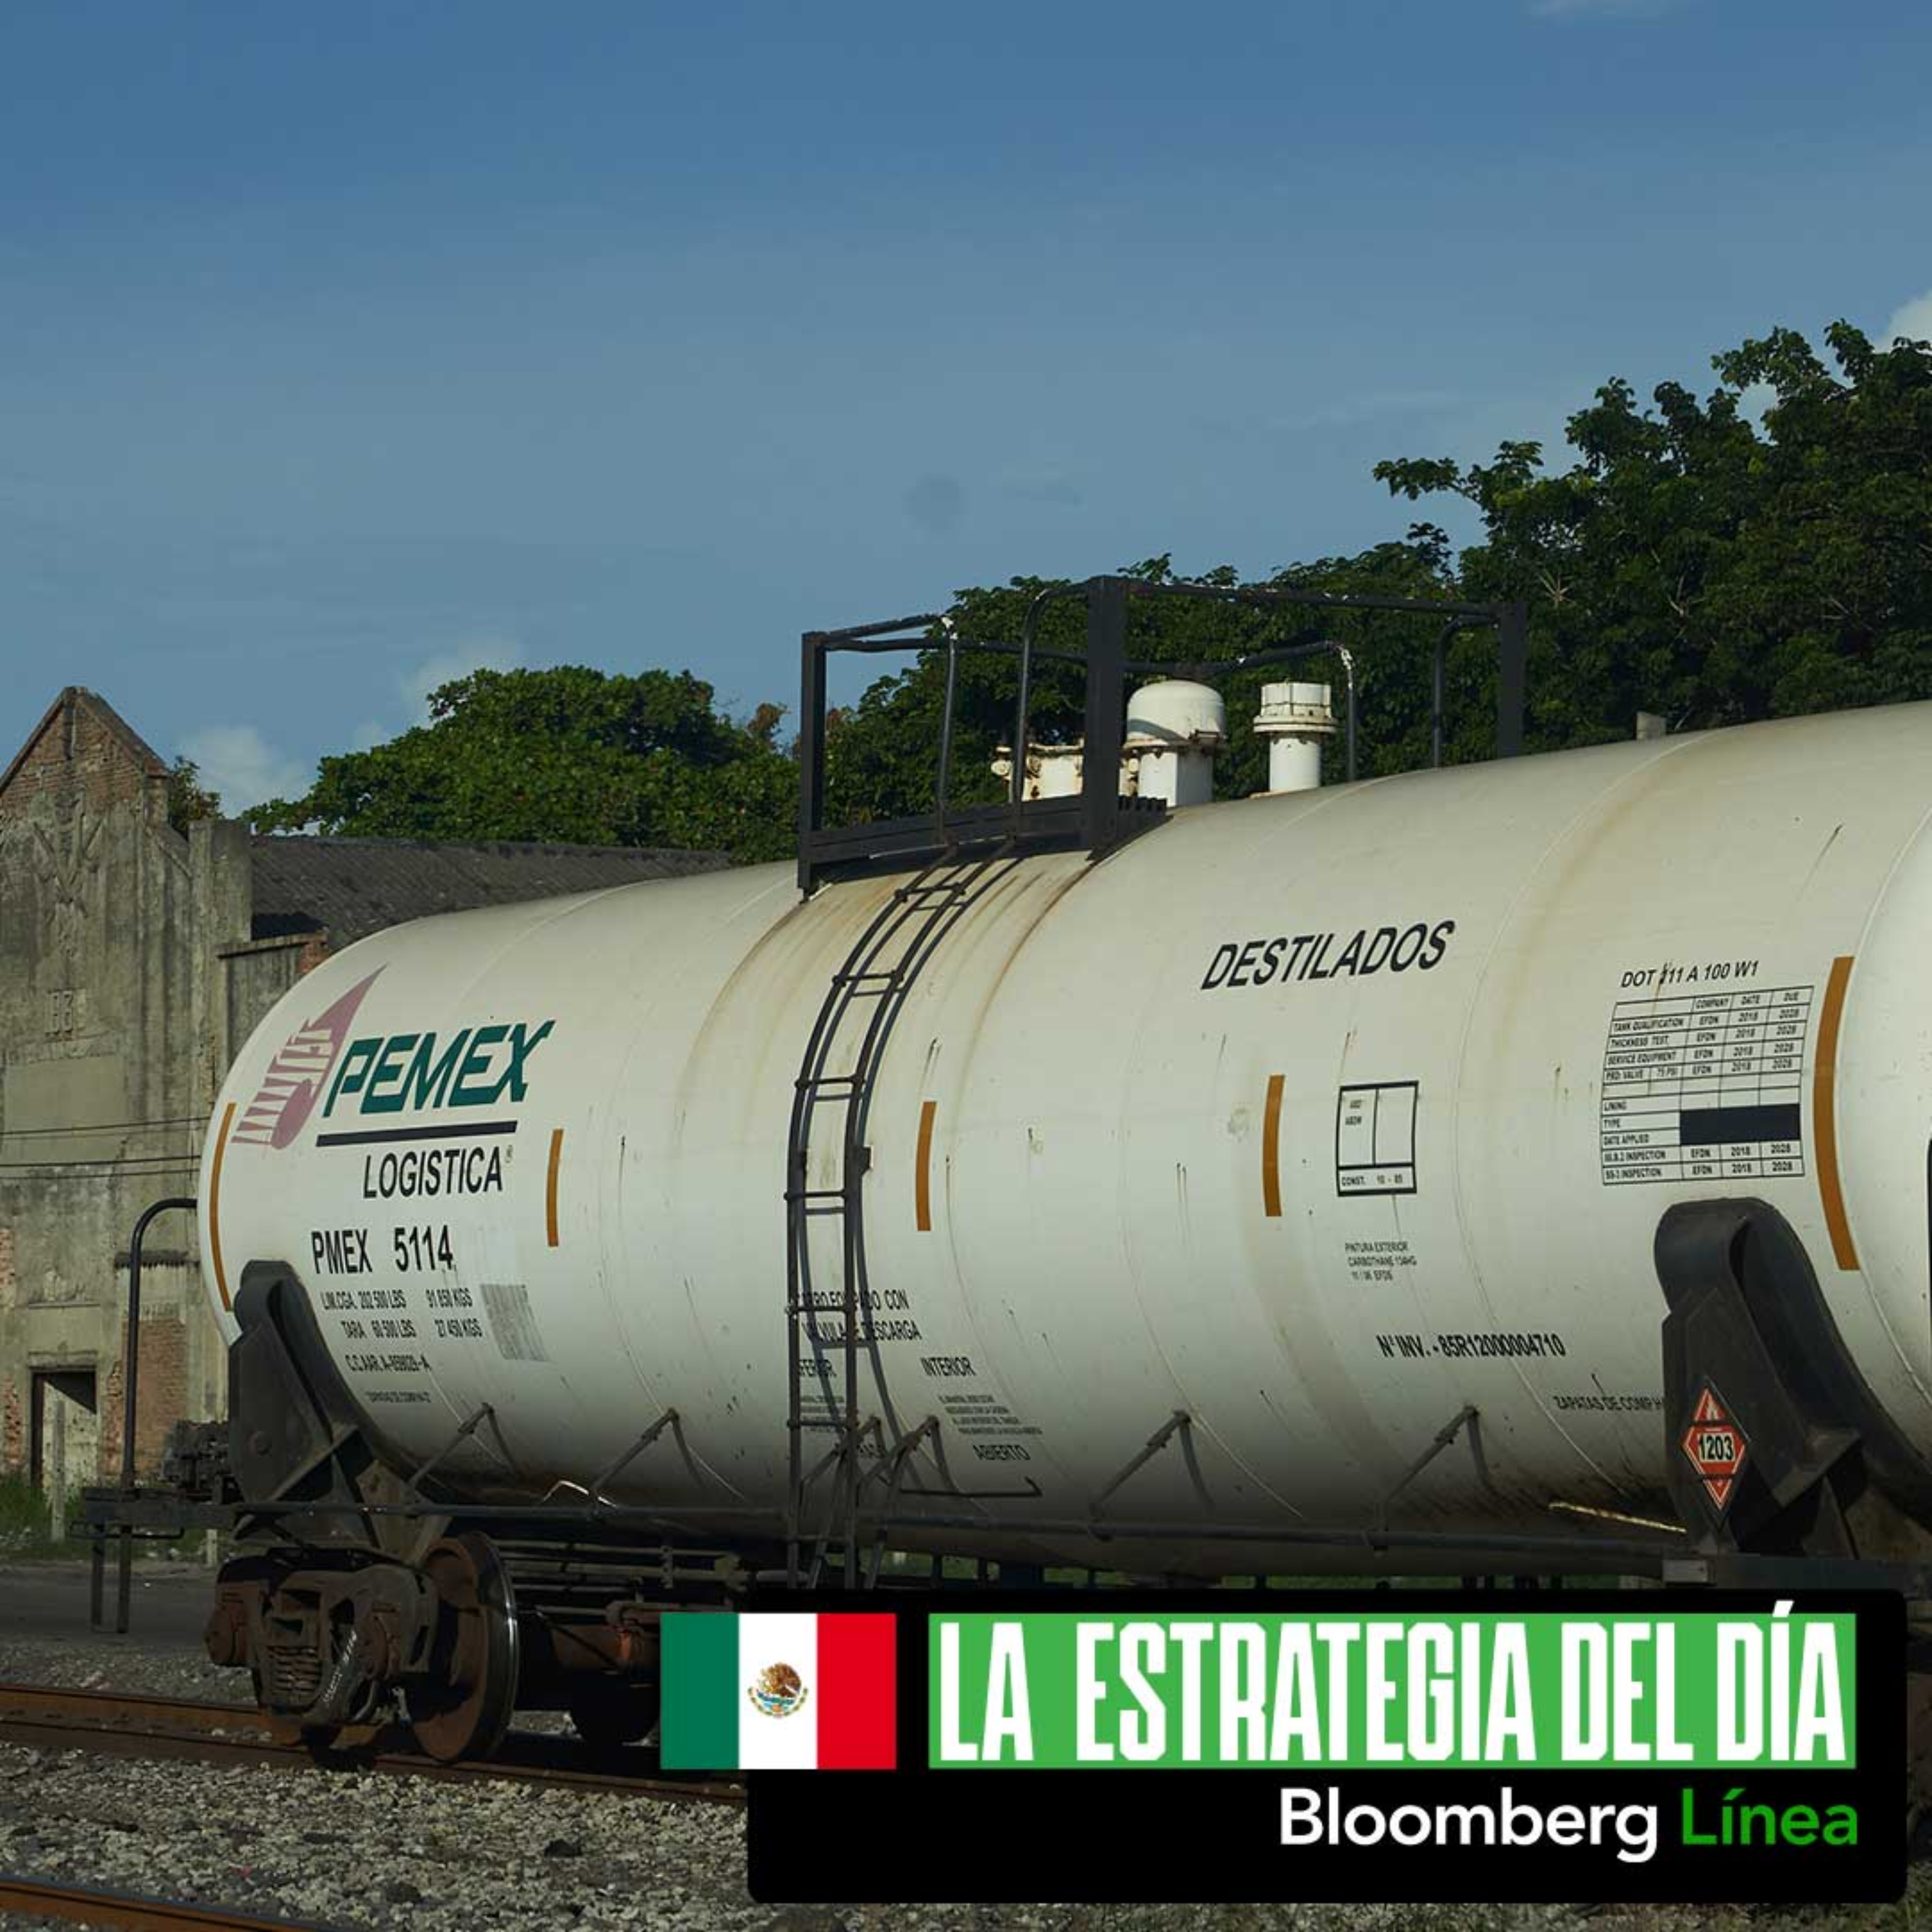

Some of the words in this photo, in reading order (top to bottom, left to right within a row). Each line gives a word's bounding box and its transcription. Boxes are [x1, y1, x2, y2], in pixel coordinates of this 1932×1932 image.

[1200, 921, 1455, 989] DESTILADOS
[1620, 970, 1657, 988] DOT
[1687, 966, 1698, 983] A
[1705, 963, 1730, 980] 100
[1734, 960, 1759, 978] W1
[323, 1020, 556, 1117] PEMEX
[363, 1146, 503, 1198] LOGISTICA
[311, 1229, 373, 1274] PMEX
[394, 1225, 453, 1271] 5114
[884, 1289, 909, 1310] CON
[920, 1356, 978, 1376] INTERIOR
[972, 1444, 1030, 1461] ABIERTO
[1699, 1435, 1734, 1461] 1203
